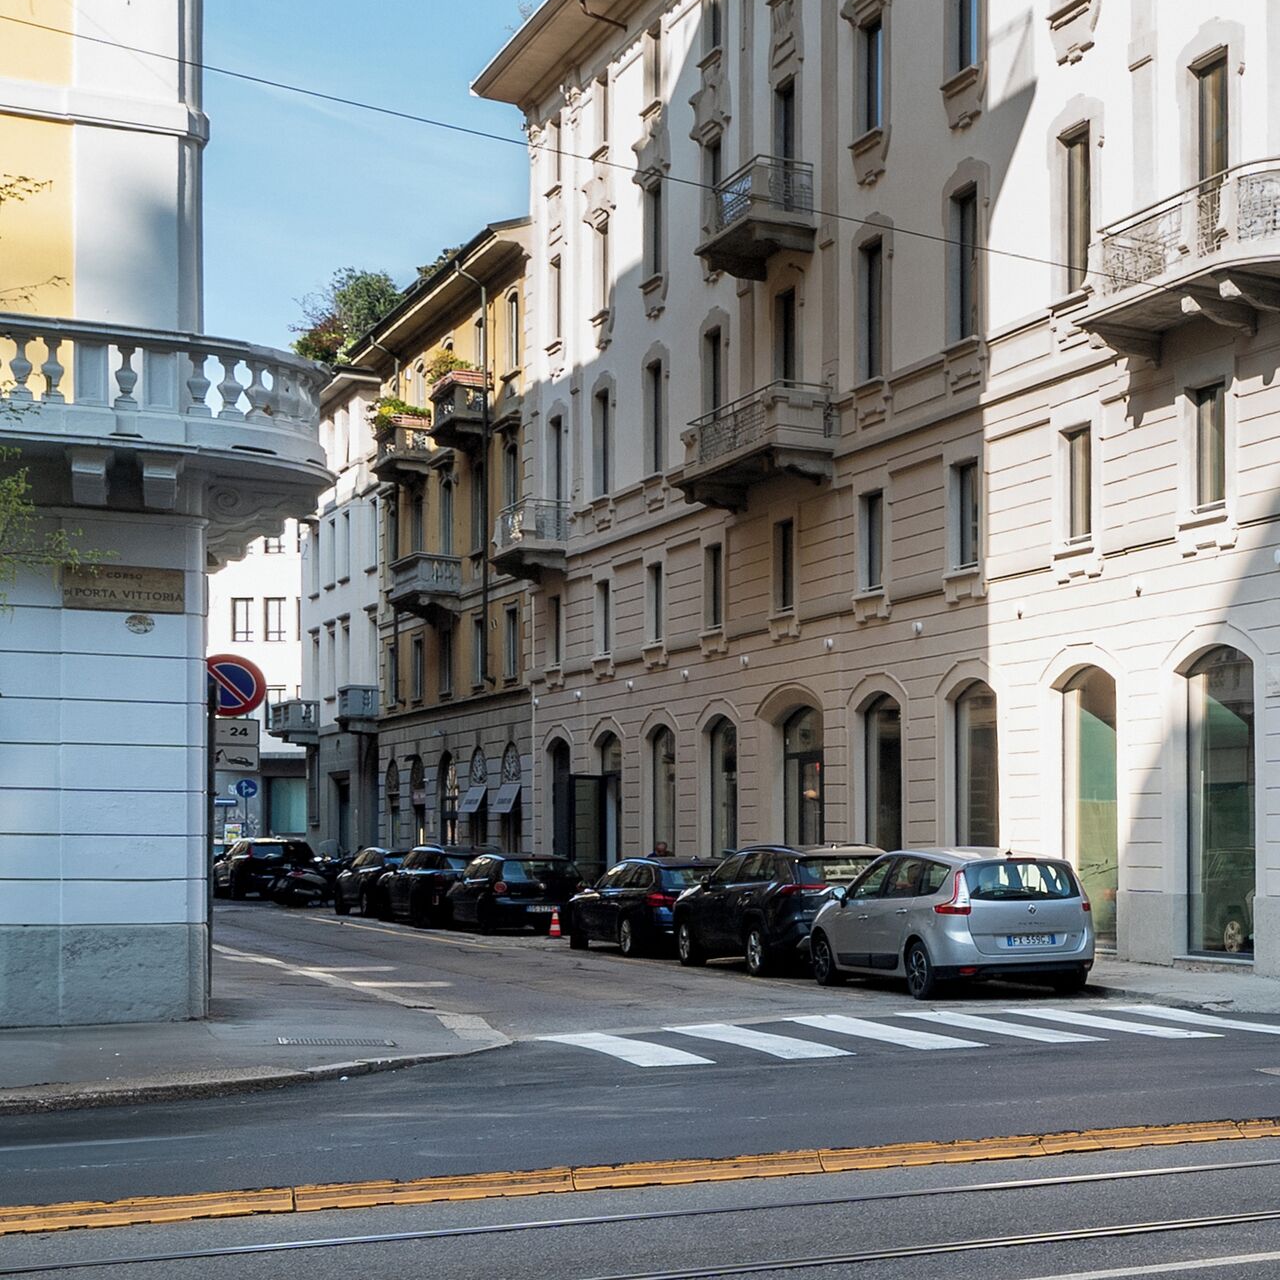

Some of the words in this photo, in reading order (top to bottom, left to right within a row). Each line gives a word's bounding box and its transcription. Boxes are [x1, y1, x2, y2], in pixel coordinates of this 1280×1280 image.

[106, 571, 143, 579] CORSO
[75, 587, 117, 599] PORTA
[122, 589, 184, 601] VITTORIA
[230, 727, 248, 736] 24
